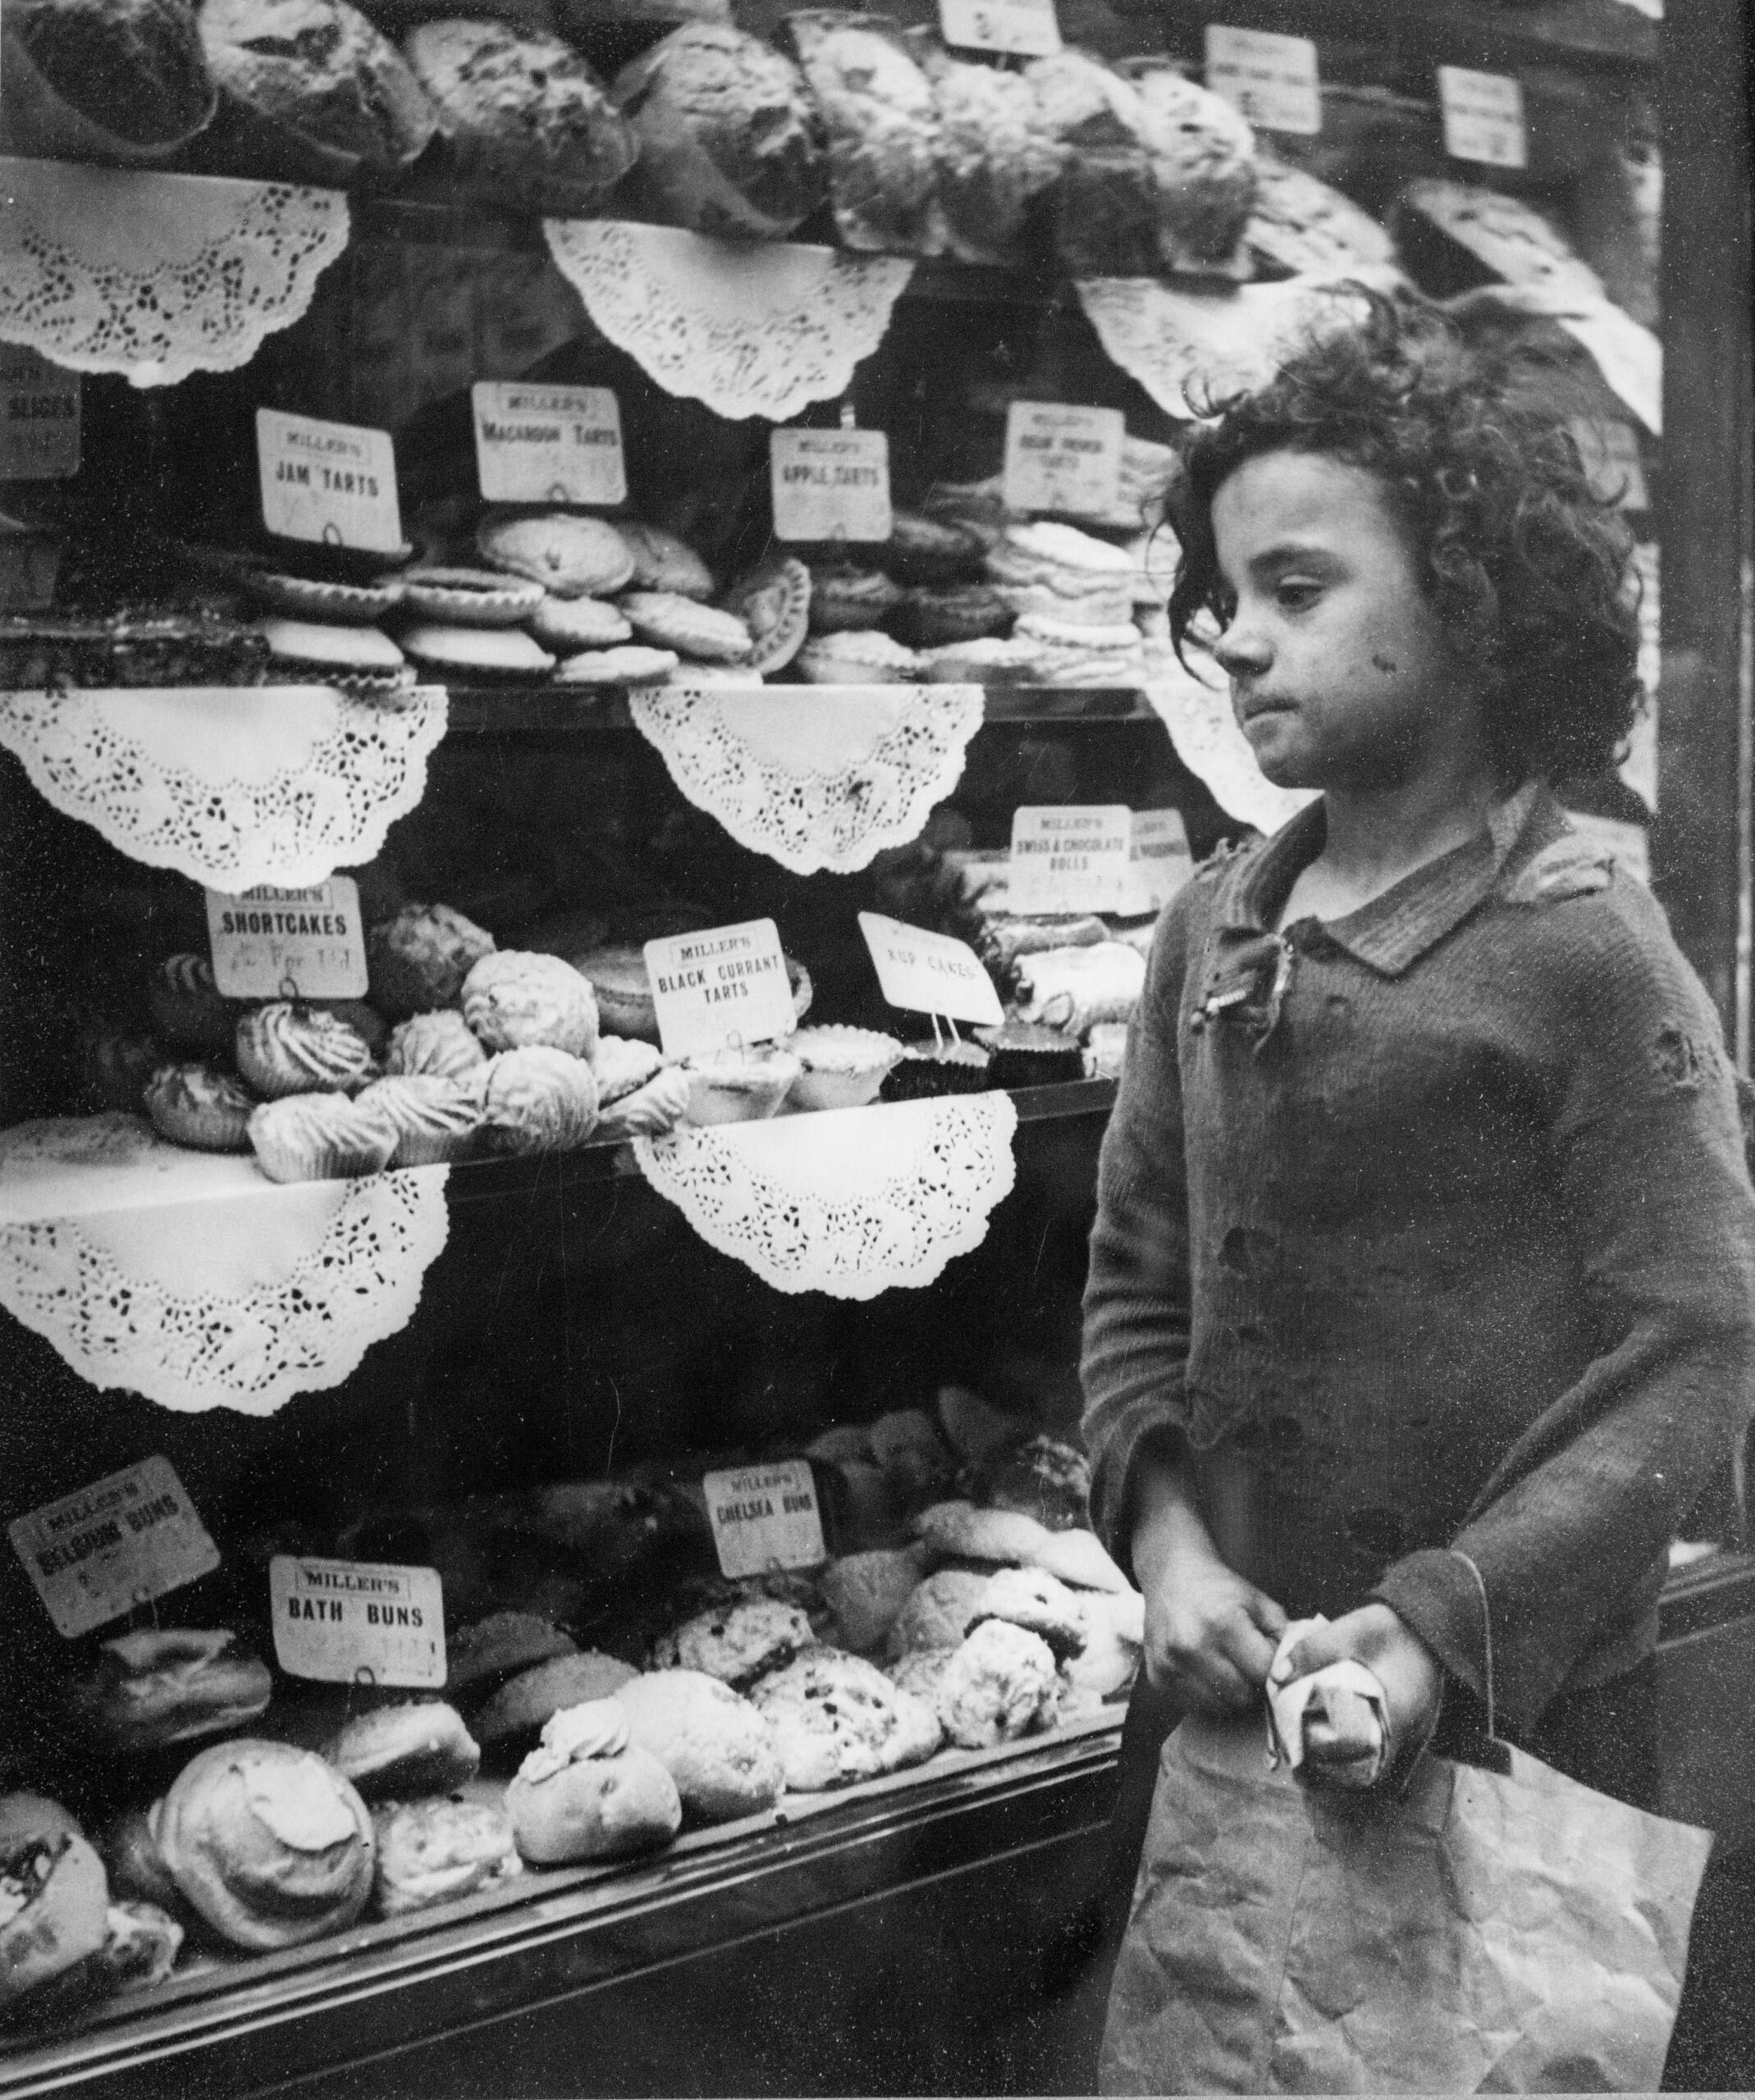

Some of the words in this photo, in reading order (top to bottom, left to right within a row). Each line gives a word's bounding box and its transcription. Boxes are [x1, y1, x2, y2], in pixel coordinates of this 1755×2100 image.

[276, 460, 310, 486] JAM
[323, 468, 379, 497] TARTS
[1049, 856, 1089, 871] ROLLS
[222, 911, 347, 936] SHORTCAKES
[679, 936, 752, 961] MILLER'S
[658, 969, 707, 993] BLACK
[717, 955, 779, 981] CURRANT
[704, 981, 749, 1004] TARTS
[126, 1493, 181, 1534] BUNS
[716, 1496, 775, 1524] CHELSEA
[304, 1571, 400, 1595] MILLER'S
[289, 1596, 344, 1622] BATH
[368, 1602, 424, 1628] BUNS
